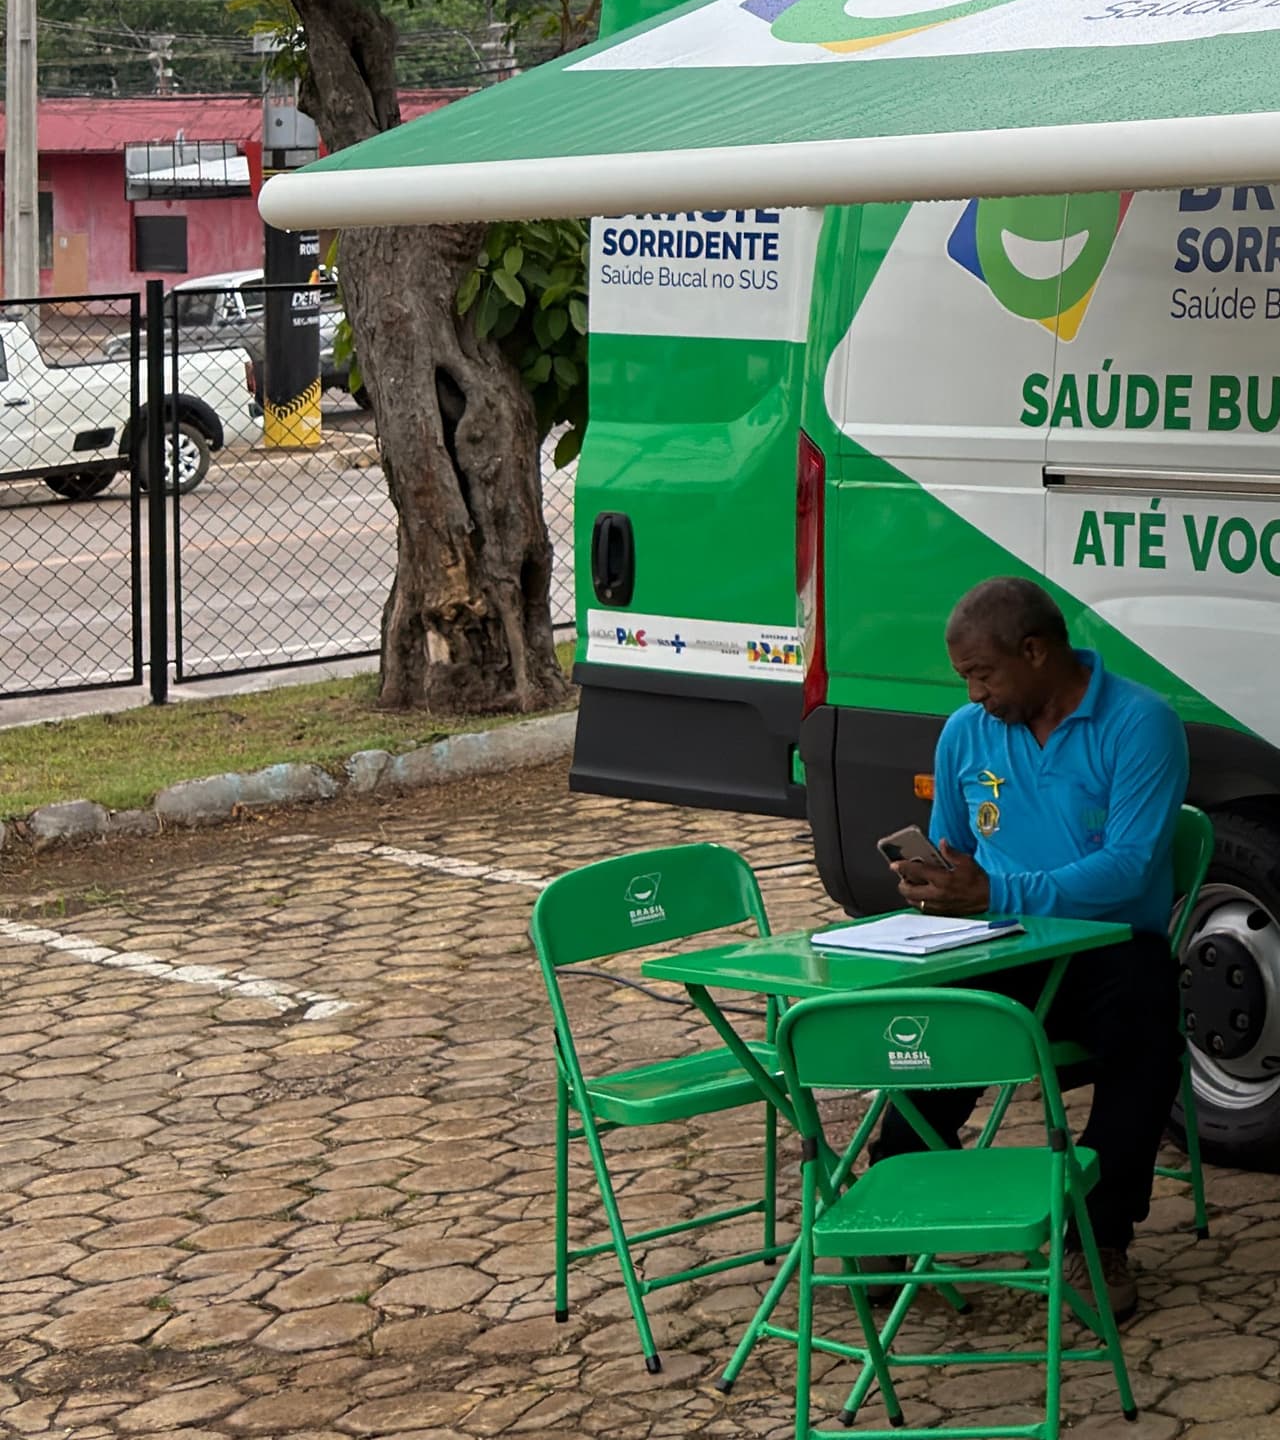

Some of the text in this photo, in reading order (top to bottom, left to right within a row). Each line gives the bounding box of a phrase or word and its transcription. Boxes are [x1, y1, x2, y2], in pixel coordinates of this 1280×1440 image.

[602, 228, 779, 261] SORRIDENTE
[601, 264, 778, 290] Saúde Bucal no SUS
[1170, 287, 1256, 319] Saúde
[1019, 358, 1193, 430] SAÚDE
[1072, 498, 1166, 569] ATÉ
[616, 627, 648, 647] PAC
[747, 641, 803, 665] BRASI
[888, 1051, 930, 1060] BRASIL
